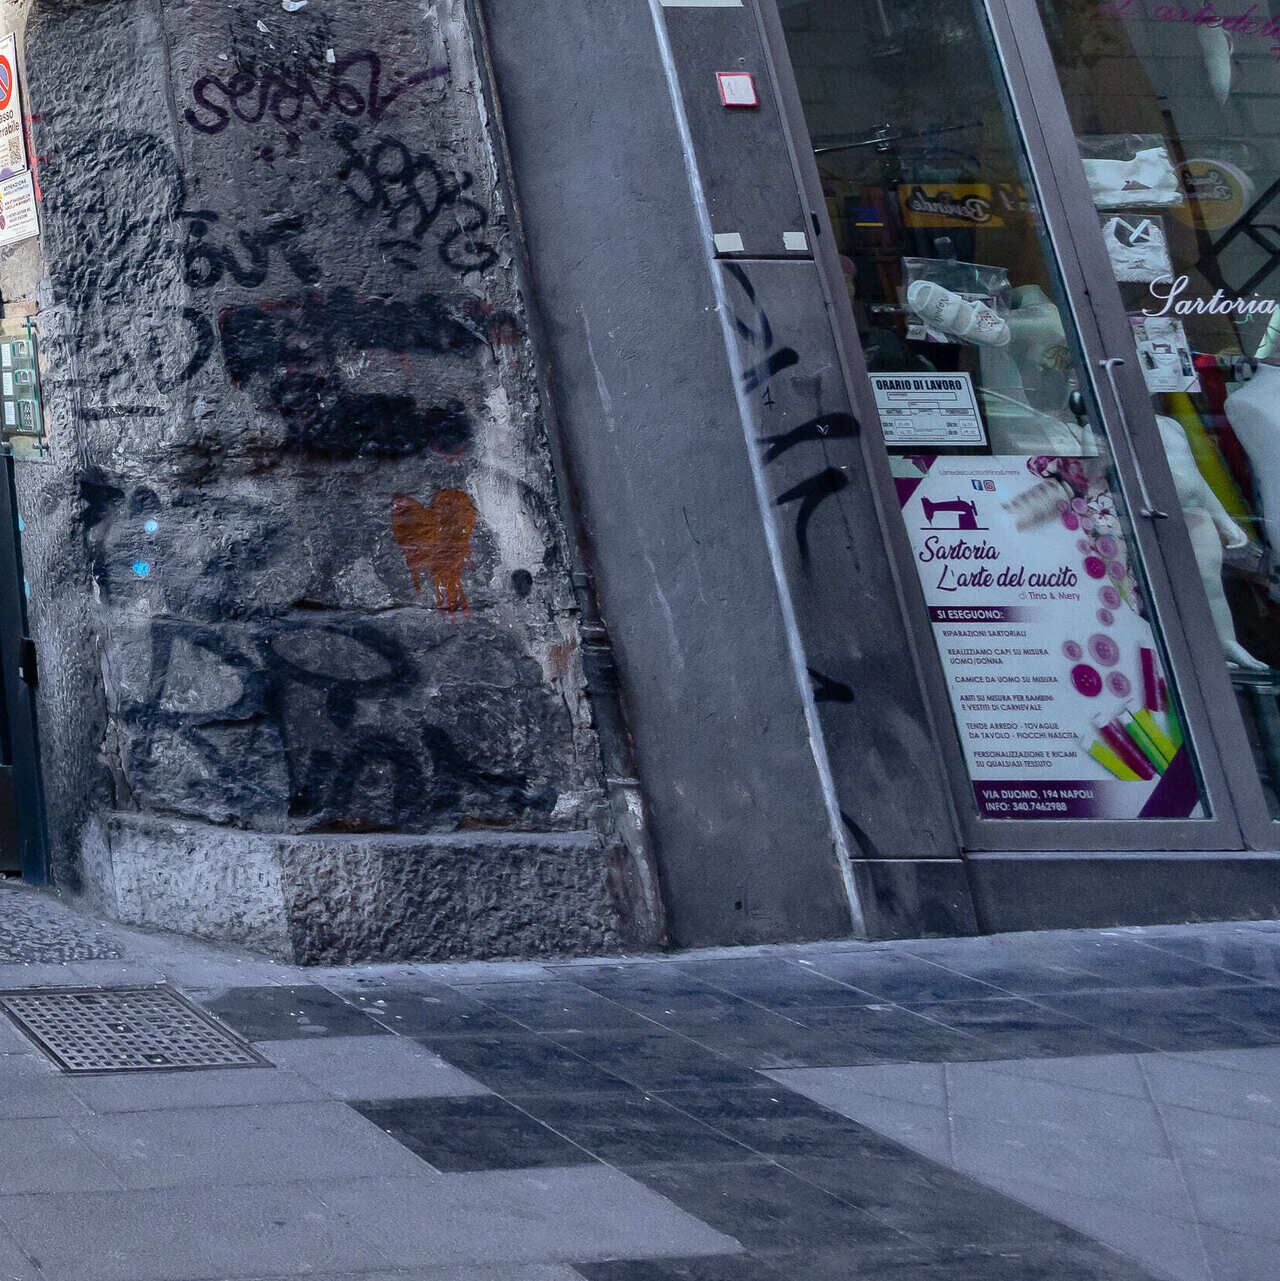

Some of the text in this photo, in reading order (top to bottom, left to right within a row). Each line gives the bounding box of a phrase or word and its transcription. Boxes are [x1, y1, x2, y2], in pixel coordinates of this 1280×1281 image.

[1142, 275, 1278, 318] Sartoria
[876, 379, 963, 391] ORARIO DI LAVORO
[919, 535, 1001, 563] Sartoria
[996, 565, 1026, 588] del
[1028, 566, 1078, 588] cucito
[936, 610, 1004, 619] SI ESEGUONO:
[1012, 648, 1022, 656] SU
[1023, 648, 1049, 656] MISURA
[977, 694, 985, 702] SU
[986, 694, 1011, 702] MISURA
[1012, 694, 1024, 702] PER
[966, 722, 1059, 730] TENDE ARREDO TOVAGLIE
[975, 760, 985, 768] SU
[1023, 760, 1053, 768] TESSUTO
[982, 790, 999, 799] VIA
[1042, 789, 1058, 799] 194
[1059, 789, 1094, 799] NAPOLI
[985, 802, 1011, 811] INFO:
